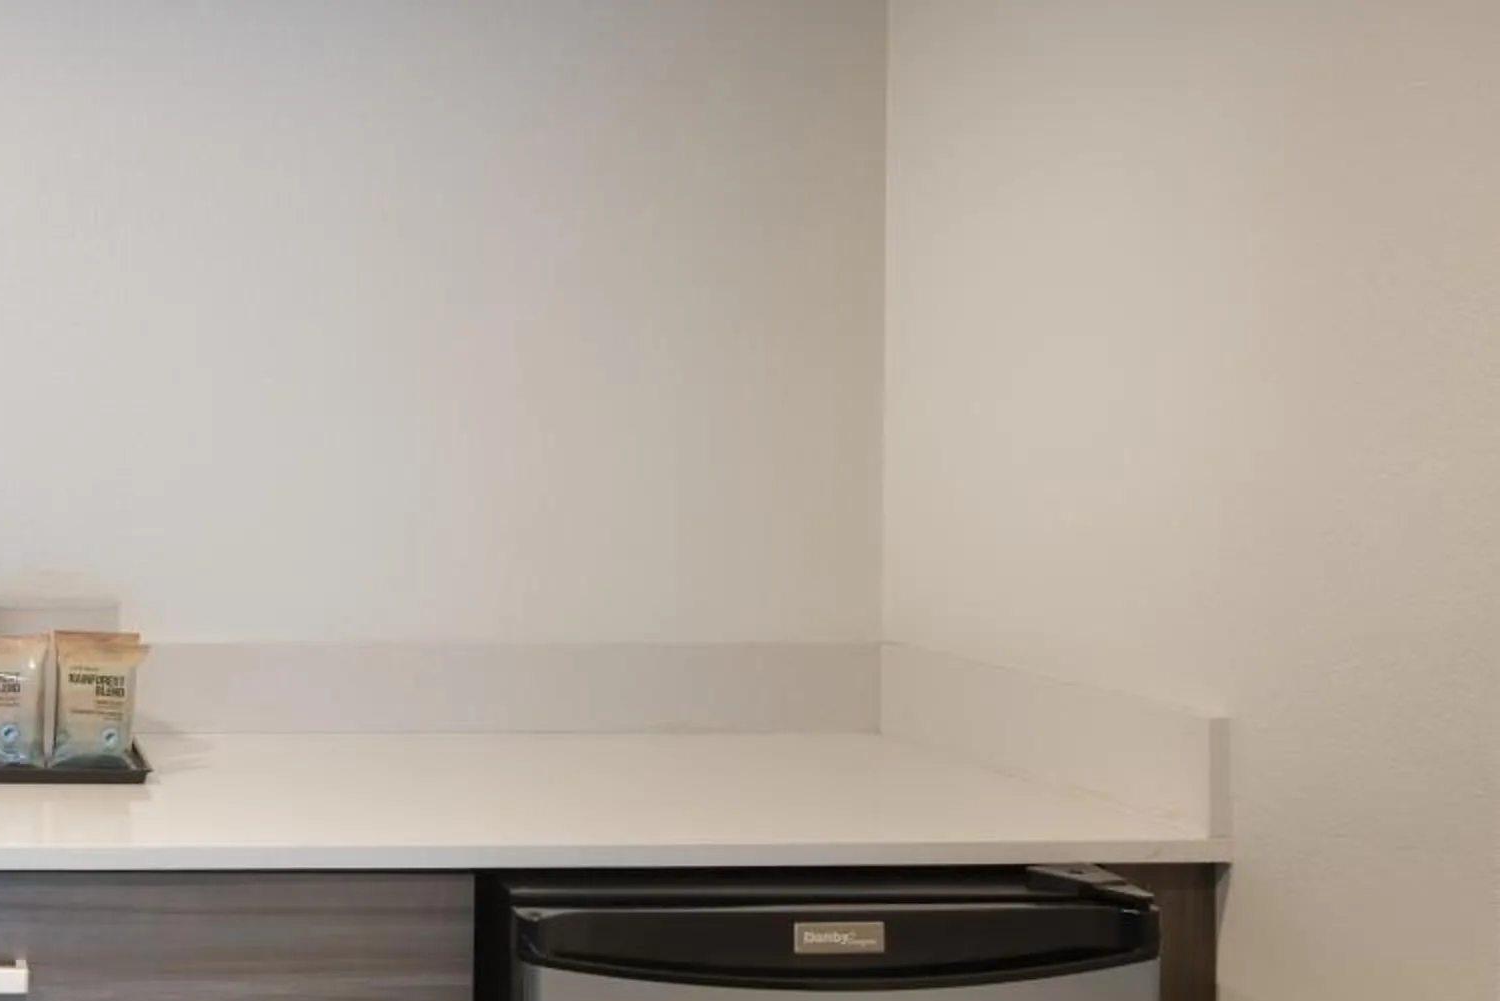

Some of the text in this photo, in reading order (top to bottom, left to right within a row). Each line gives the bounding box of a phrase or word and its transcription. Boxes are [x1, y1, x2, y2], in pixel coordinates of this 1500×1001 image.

[68, 673, 125, 687] RAINFOREST
[95, 685, 125, 697] BLEND
[803, 931, 849, 945] Danby
